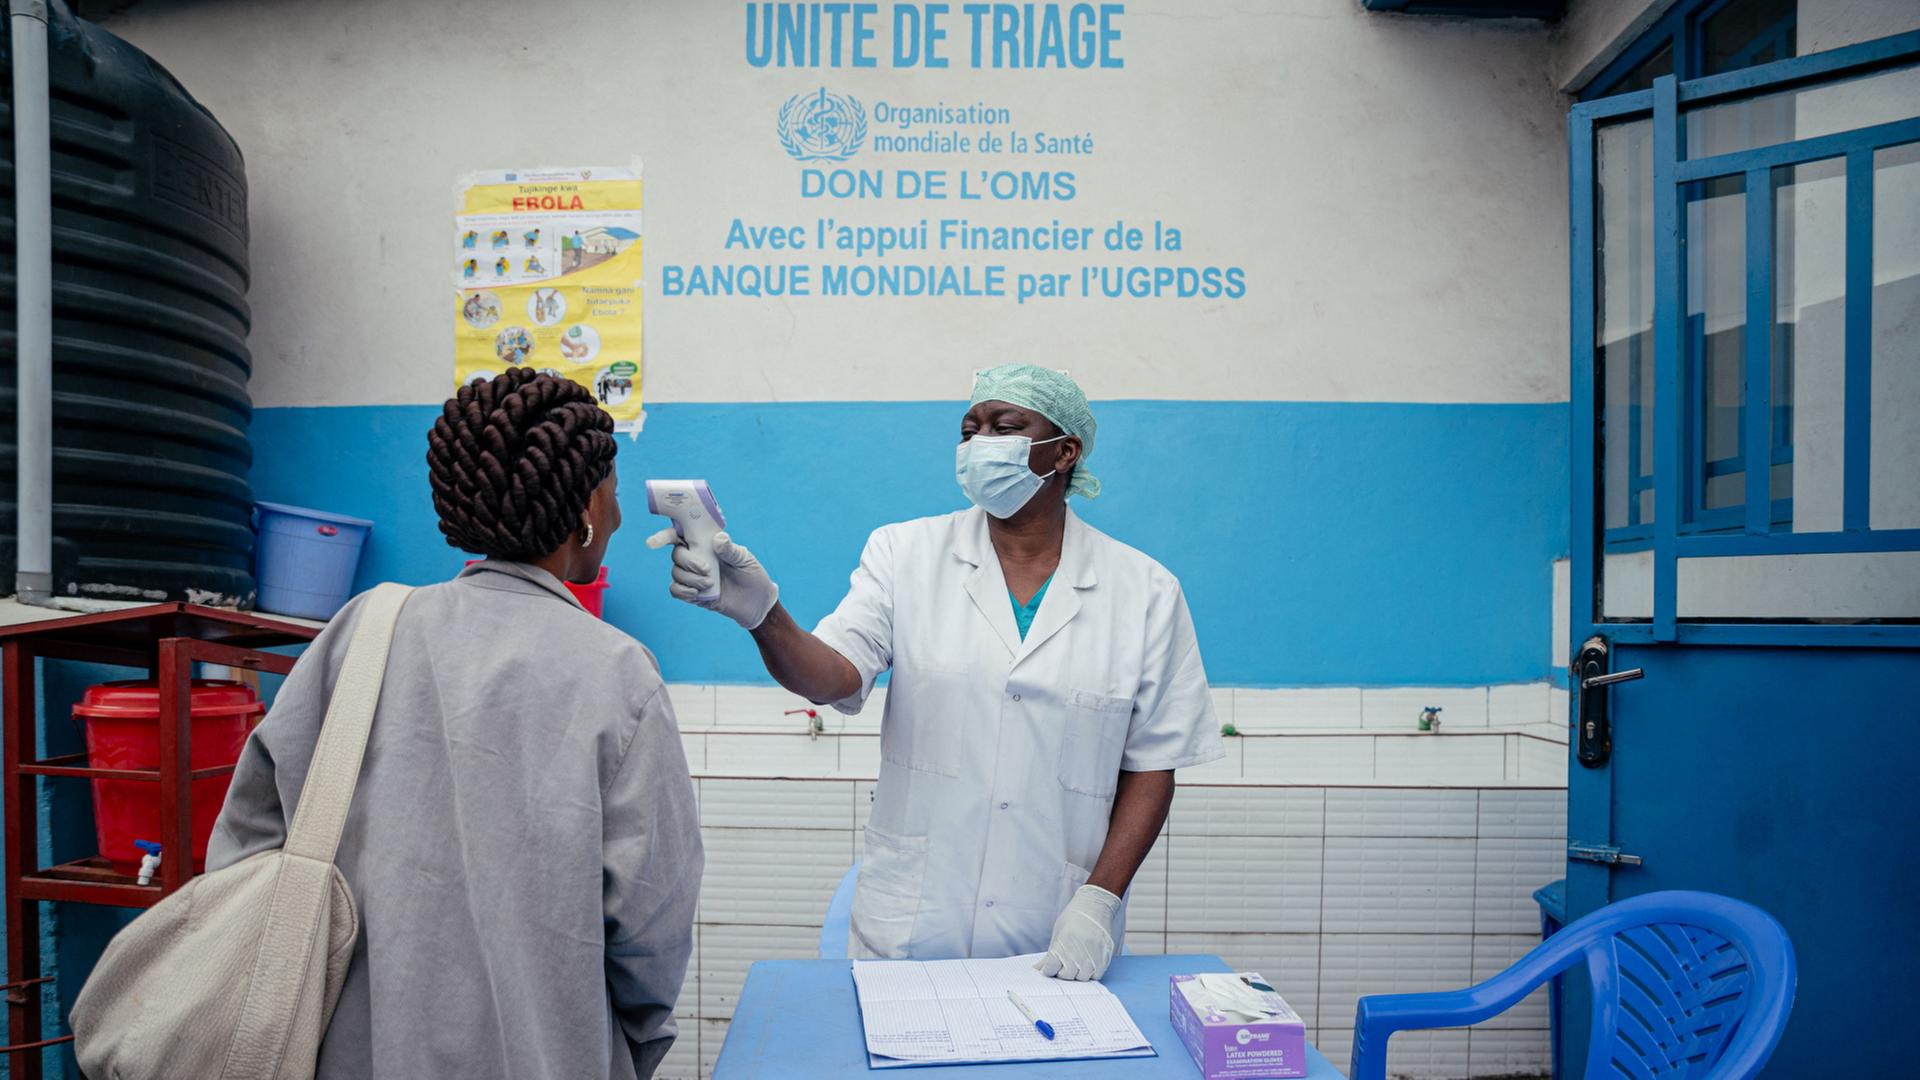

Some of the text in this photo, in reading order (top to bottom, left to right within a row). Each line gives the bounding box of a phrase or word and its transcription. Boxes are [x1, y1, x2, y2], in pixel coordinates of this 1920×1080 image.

[746, 2, 1125, 69] UNITE DE TRIAGE
[874, 102, 1010, 127] Organisation
[874, 132, 1093, 154] mondiale de la Santé
[801, 169, 1076, 200] DON DE L'OMS
[512, 195, 584, 211] EBOLA
[725, 219, 1182, 257] Avec l'appui Financier de la
[662, 265, 810, 296] BANQUE
[822, 265, 1005, 297] MONDIALE
[1018, 274, 1071, 304] par
